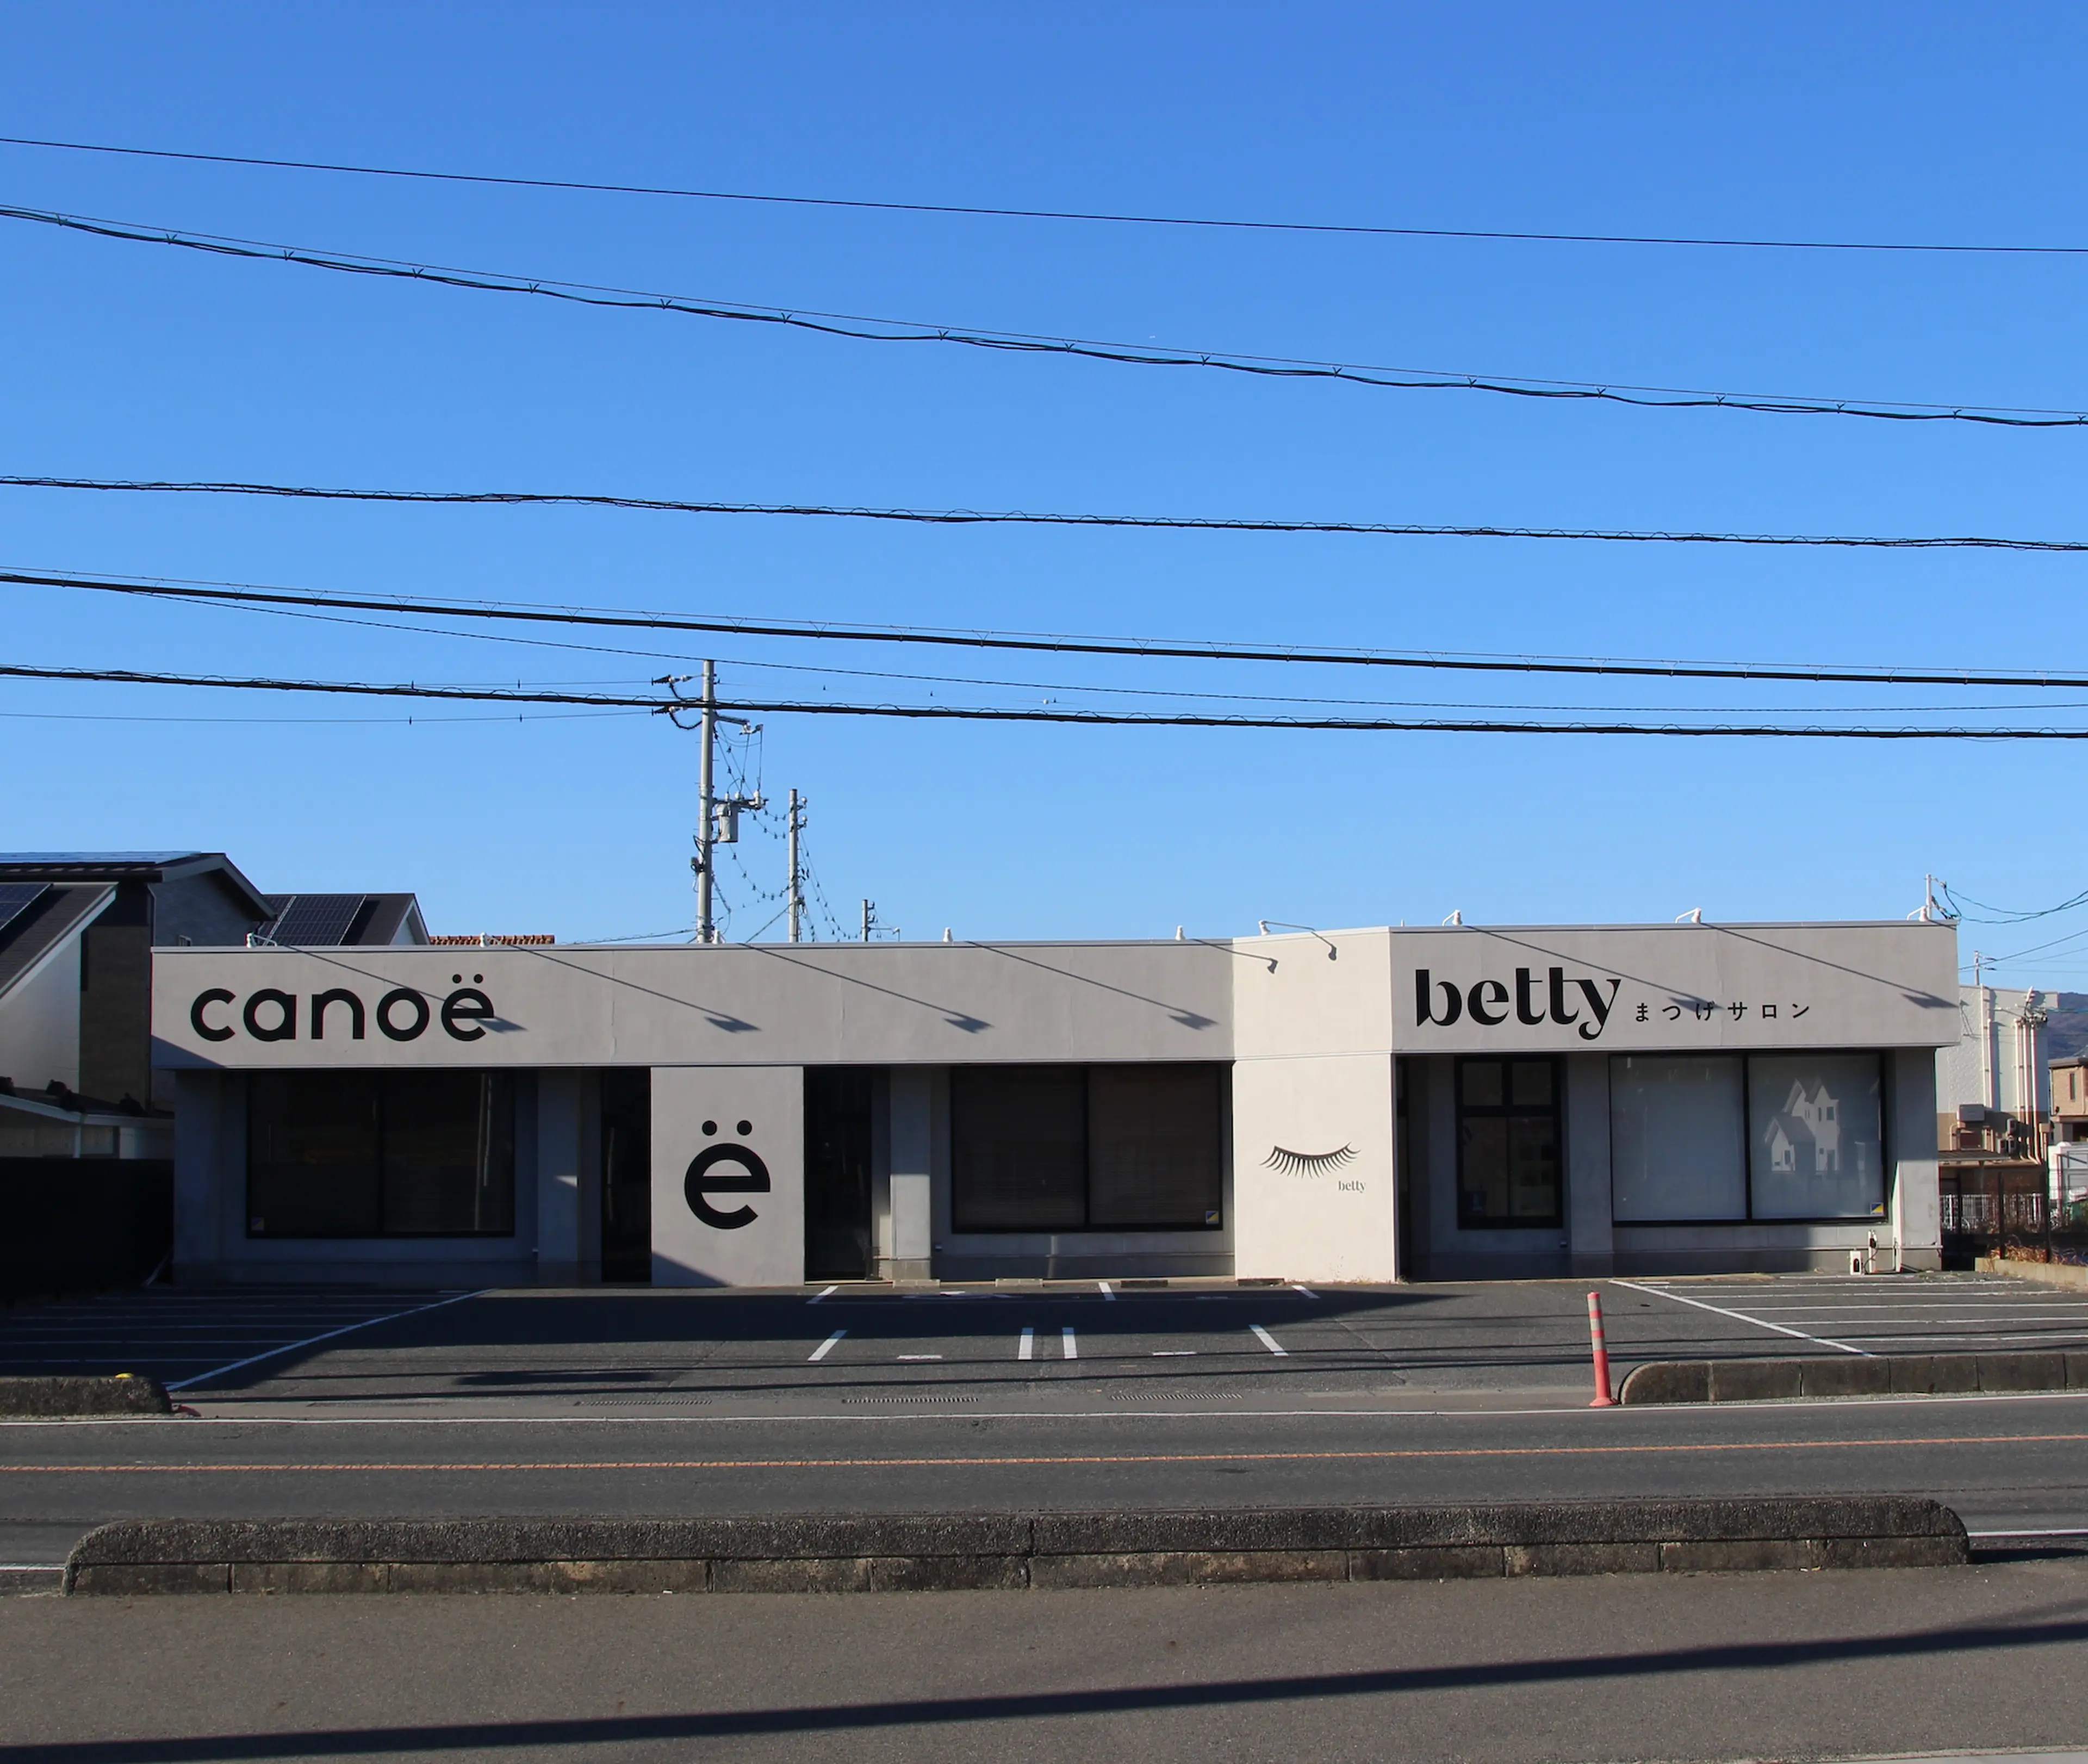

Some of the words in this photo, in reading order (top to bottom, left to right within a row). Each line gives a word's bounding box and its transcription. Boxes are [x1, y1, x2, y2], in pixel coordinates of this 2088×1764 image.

[190, 973, 495, 1042] canoë
[1415, 967, 1621, 1040] betty
[1635, 1001, 1810, 1022] まつげサロン
[684, 1120, 770, 1229] ë
[1338, 1181, 1366, 1193] betty
